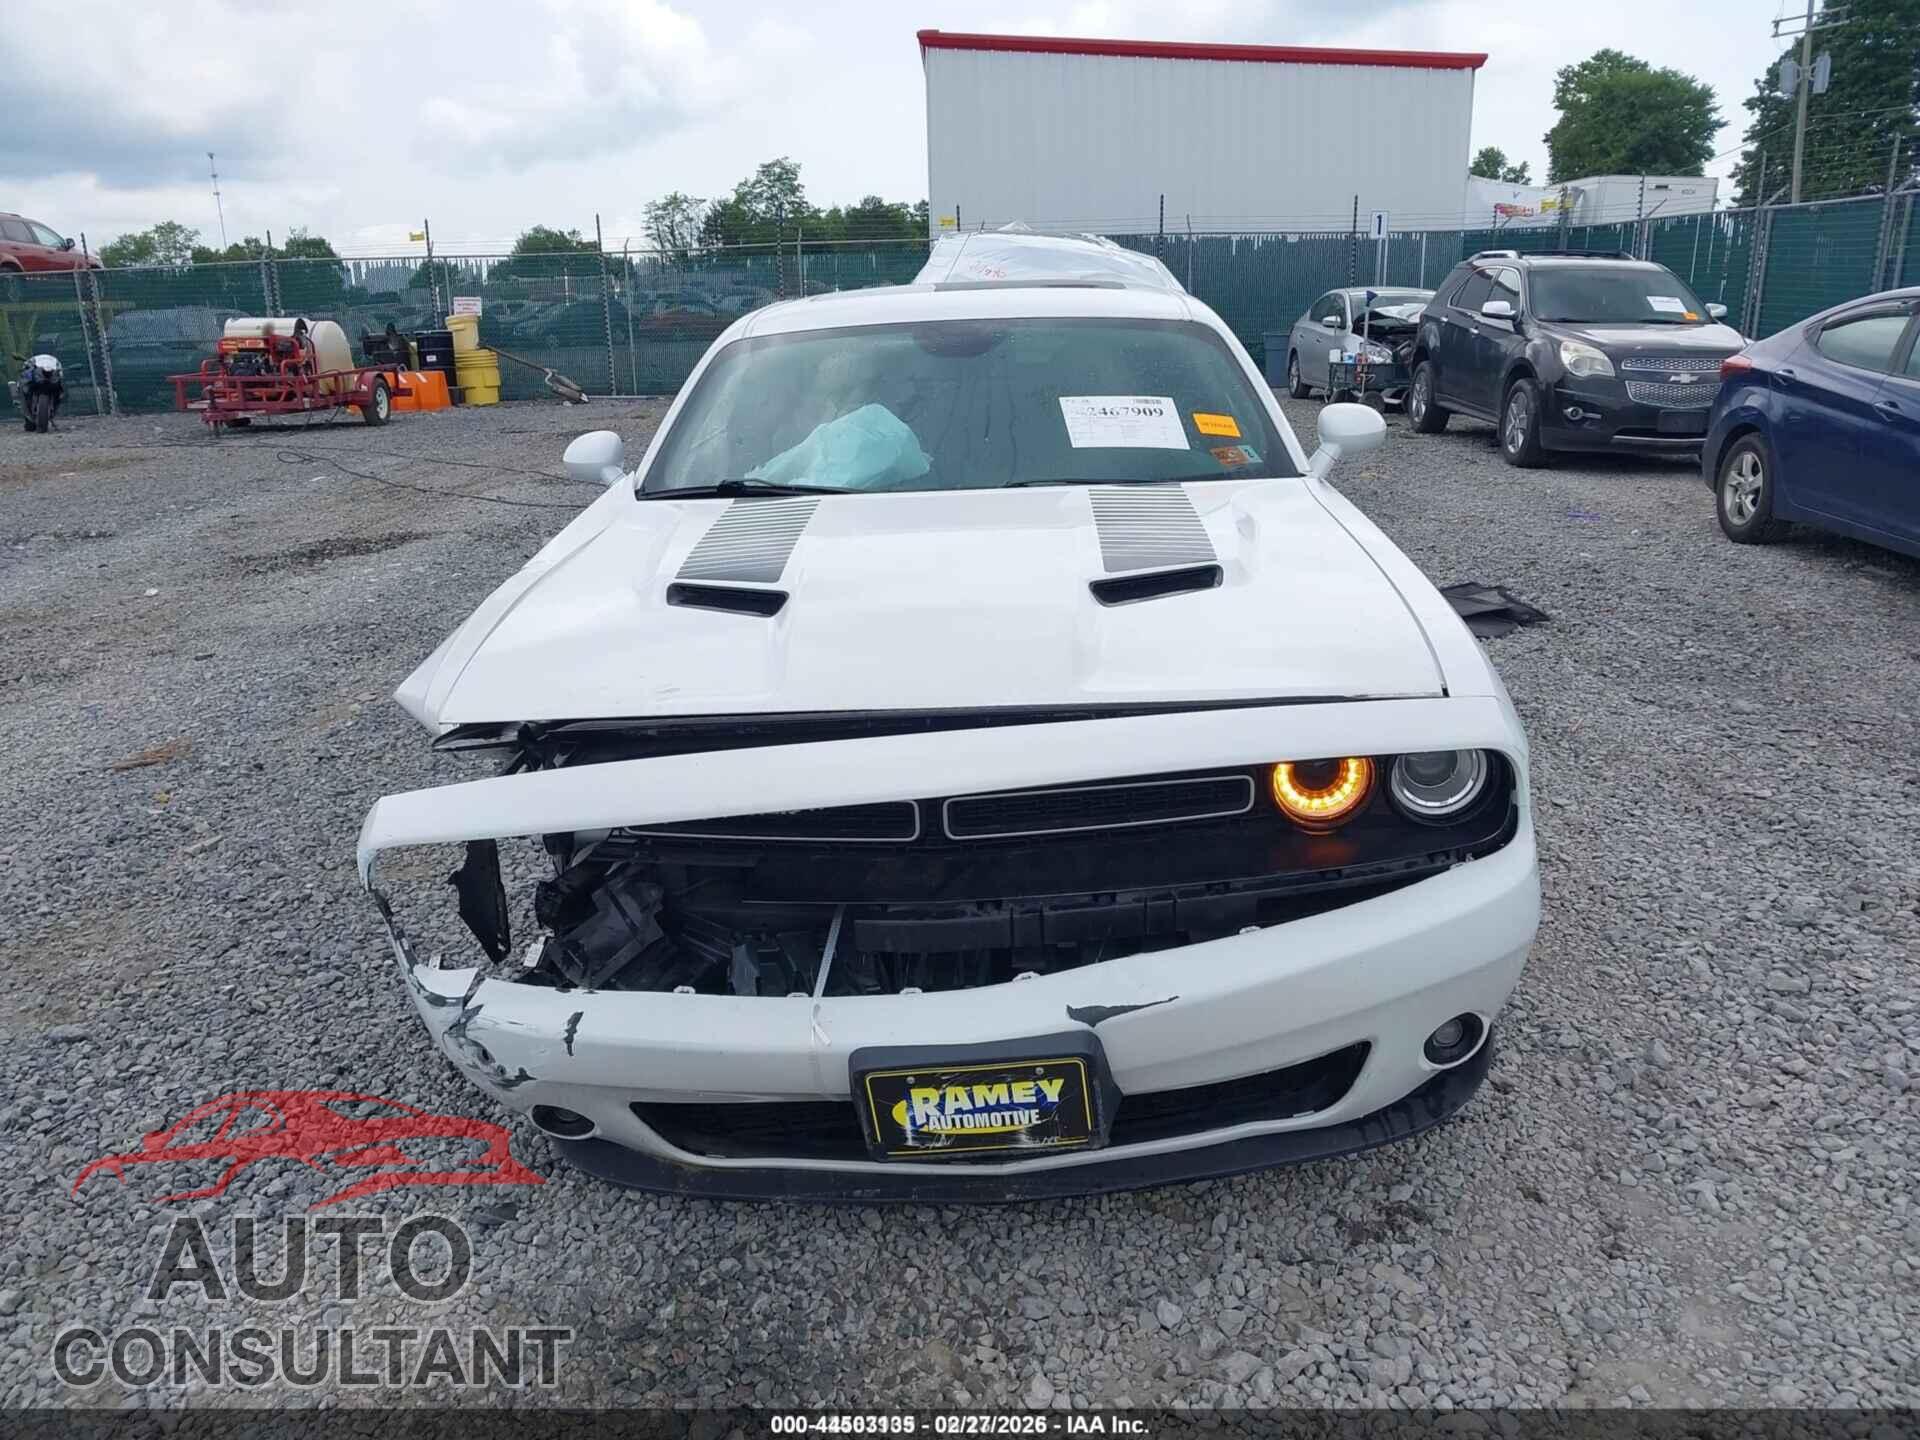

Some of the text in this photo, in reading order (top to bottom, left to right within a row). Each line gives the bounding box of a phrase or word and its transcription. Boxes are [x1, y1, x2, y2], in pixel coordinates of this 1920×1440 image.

[1376, 214, 1383, 236] 1
[1075, 406, 1164, 417] 2467909
[908, 1078, 1065, 1126] RAMEY
[927, 1108, 1041, 1131] AUTOMOTIVE
